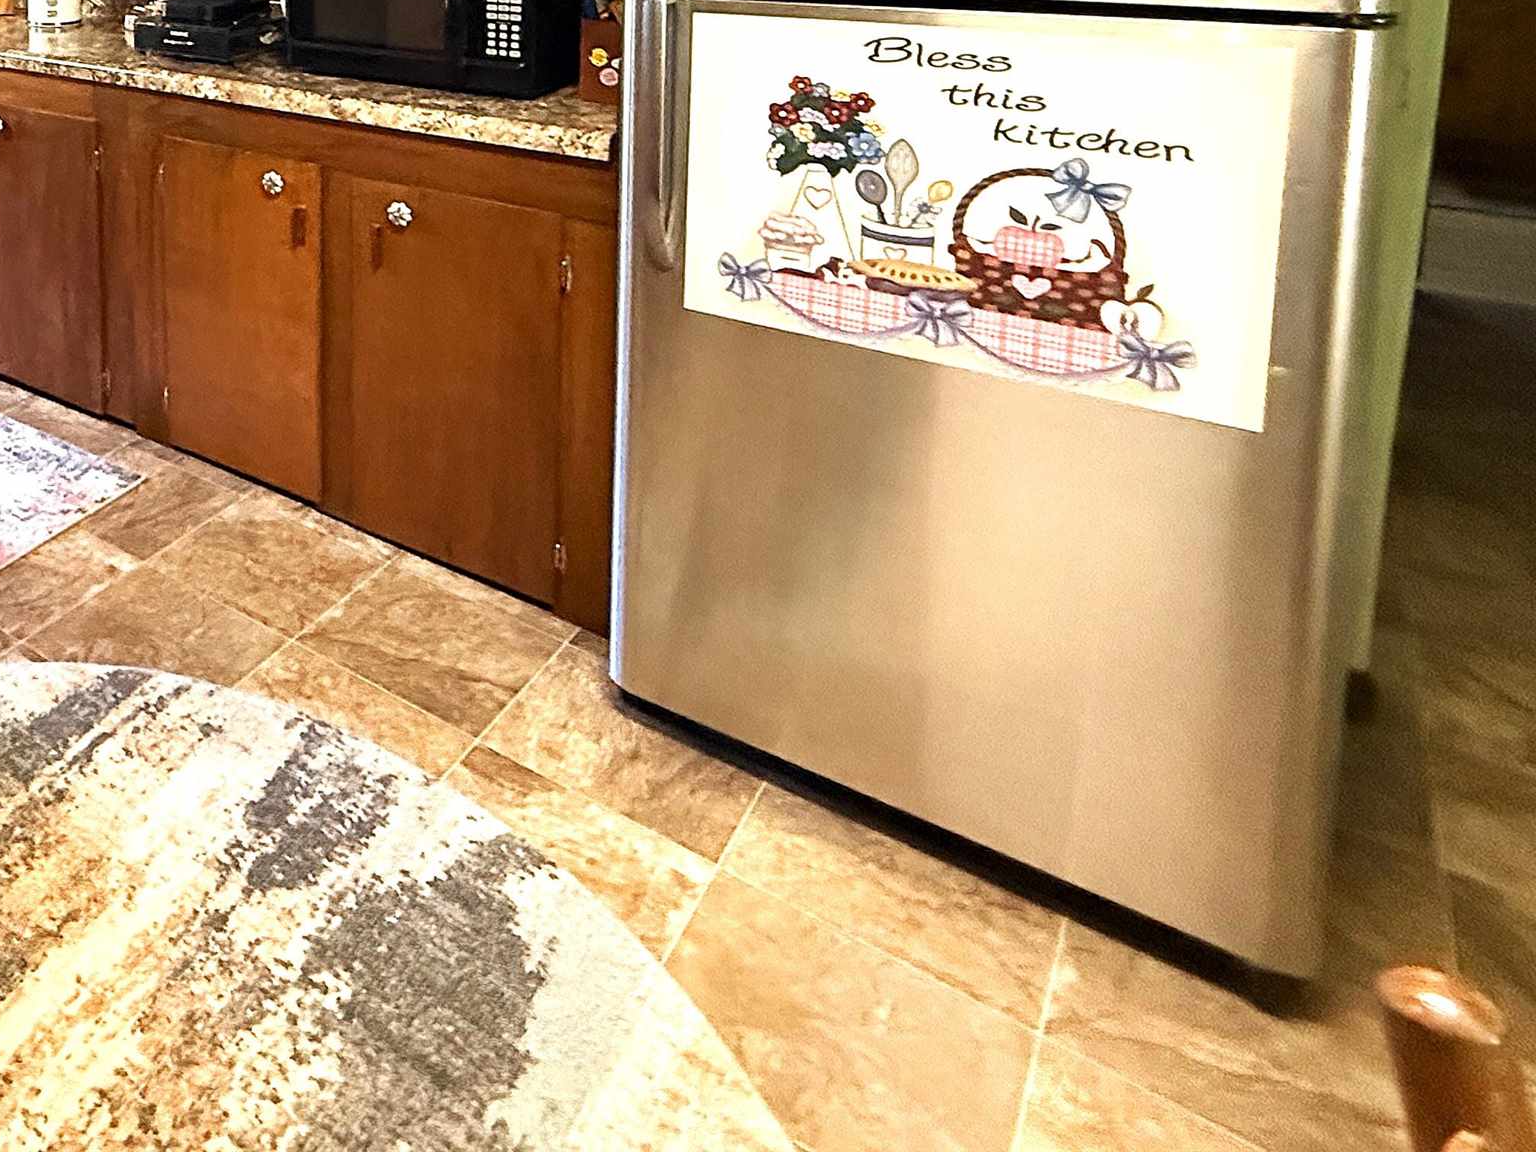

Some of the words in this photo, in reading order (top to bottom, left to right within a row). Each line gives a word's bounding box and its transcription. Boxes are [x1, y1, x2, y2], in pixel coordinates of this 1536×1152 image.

[864, 36, 1012, 73] Bless
[941, 83, 1047, 112] this
[993, 118, 1195, 162] kitchen
